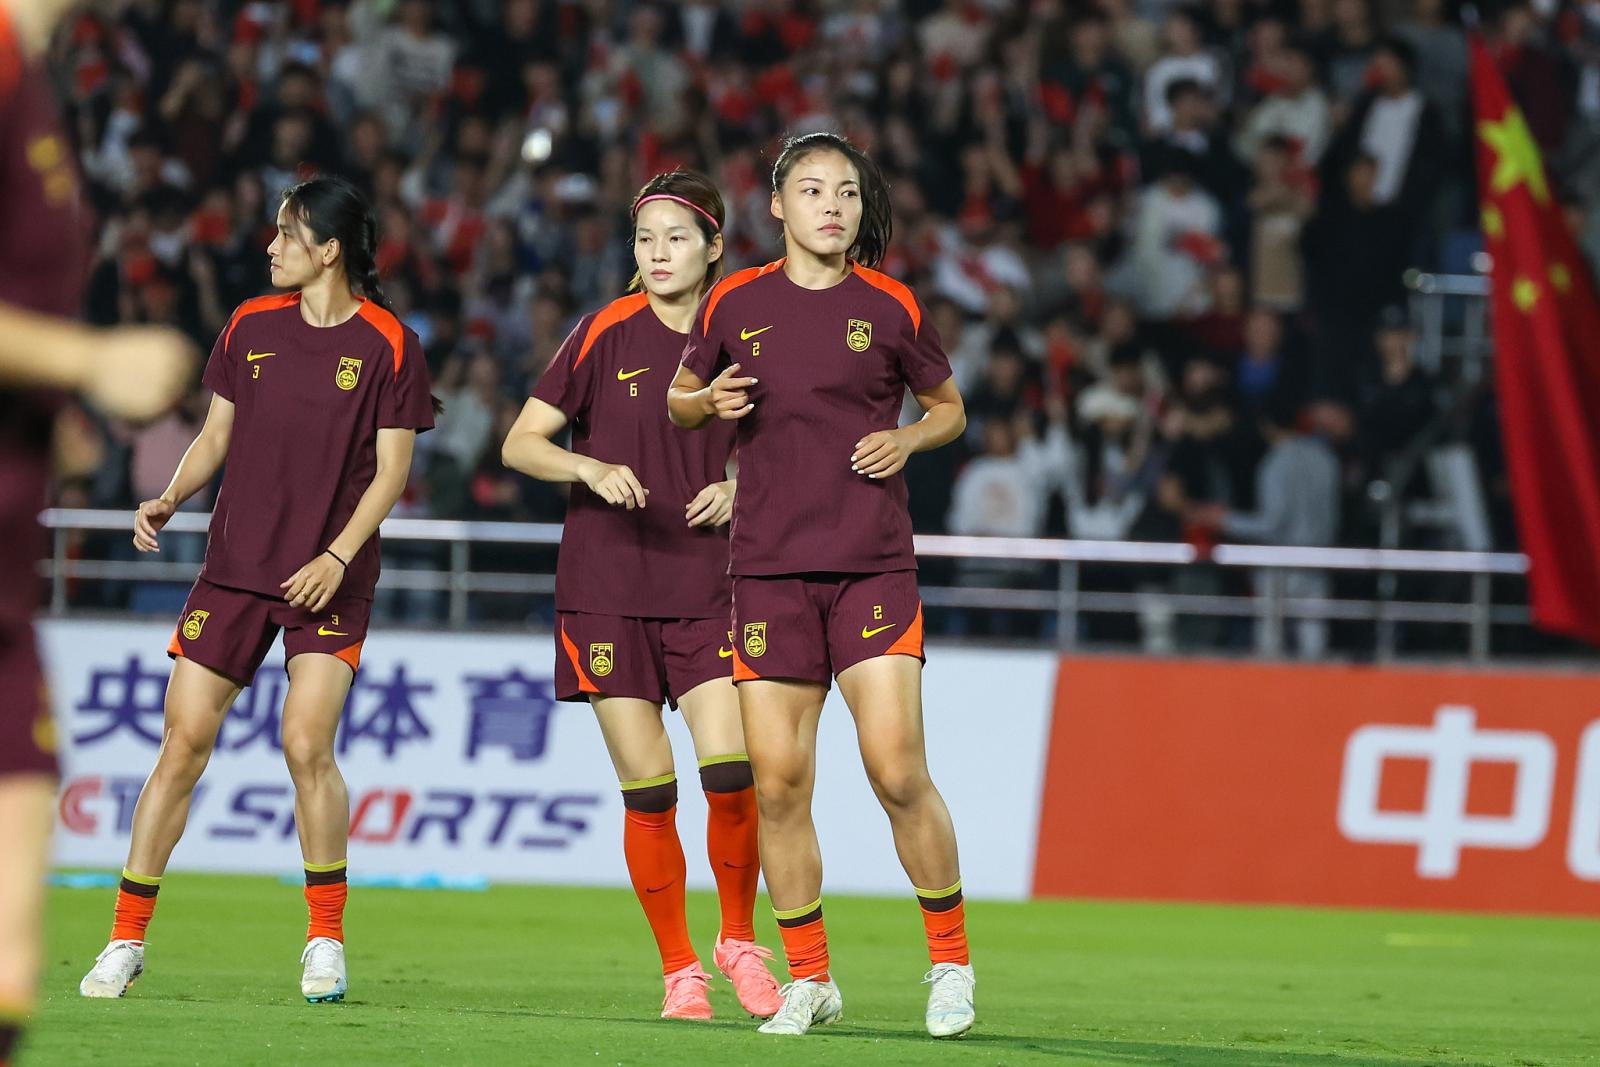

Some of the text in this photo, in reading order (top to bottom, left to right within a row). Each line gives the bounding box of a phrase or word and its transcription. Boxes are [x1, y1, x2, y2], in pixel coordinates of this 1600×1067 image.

[752, 341, 760, 356] 2
[252, 364, 260, 379] 3
[630, 382, 638, 397] 6
[331, 613, 339, 626] 3
[873, 605, 883, 620] 2
[1337, 704, 1600, 881] 中
[209, 786, 601, 848] SORTS
